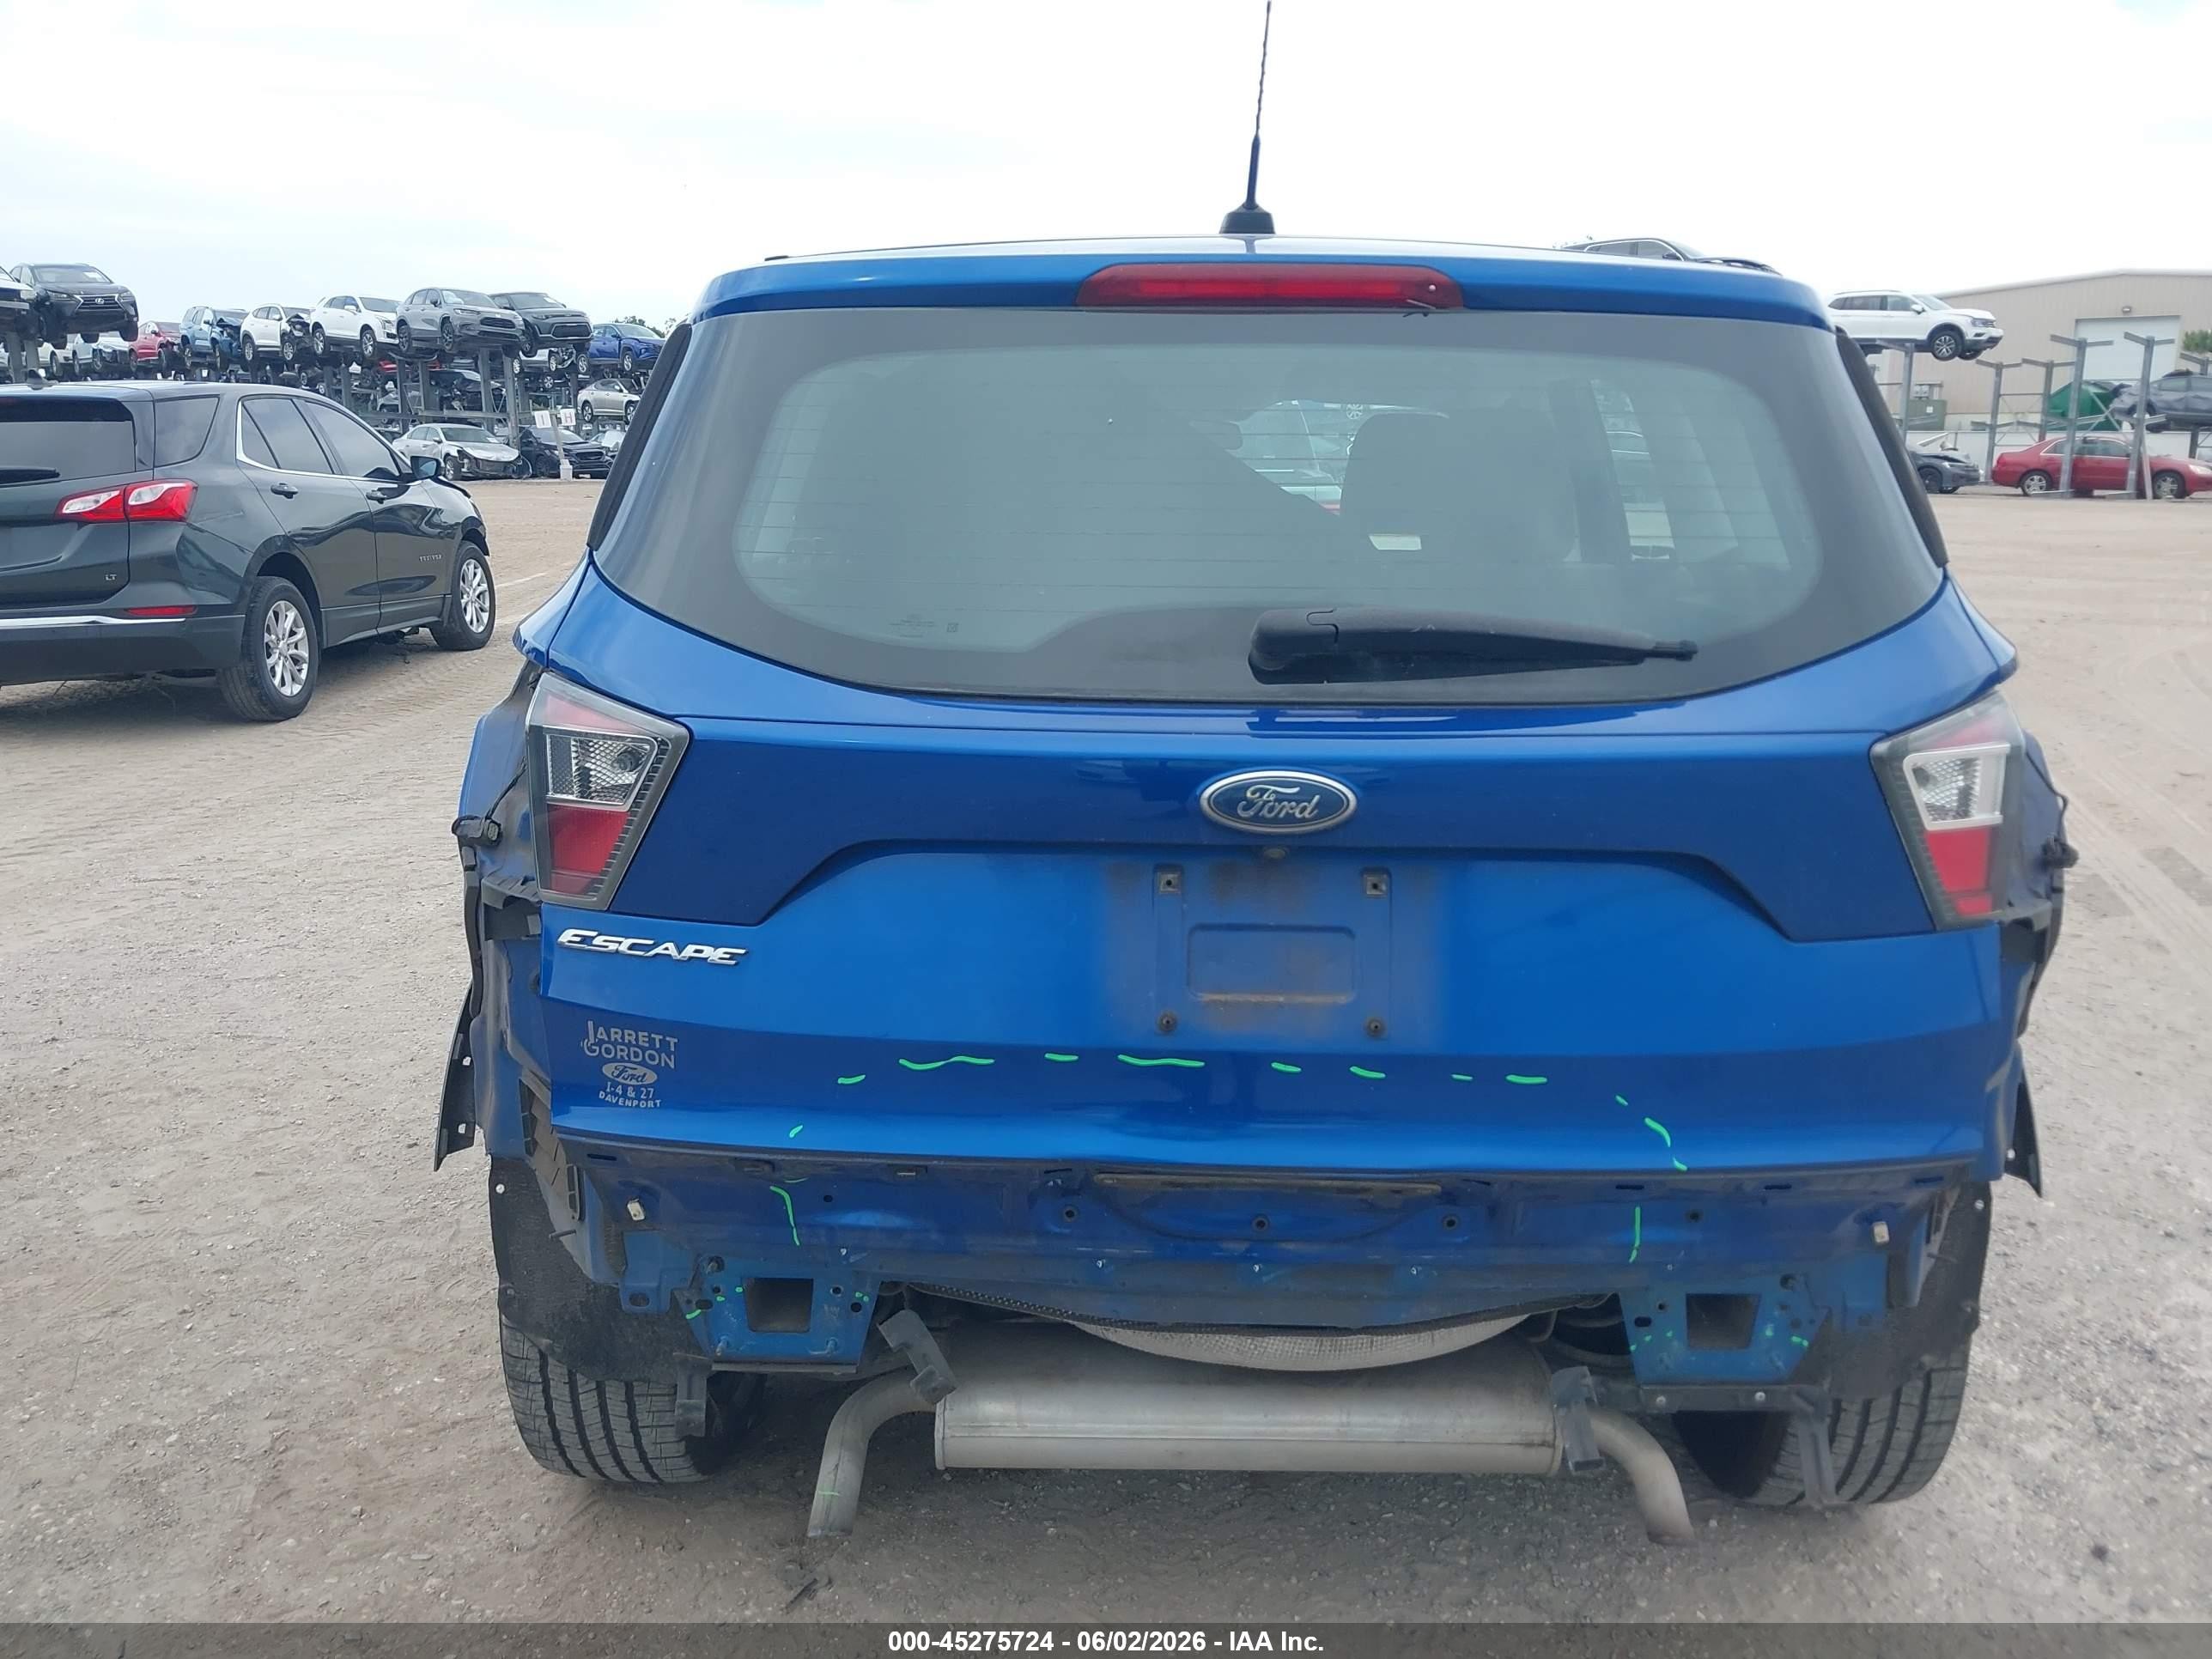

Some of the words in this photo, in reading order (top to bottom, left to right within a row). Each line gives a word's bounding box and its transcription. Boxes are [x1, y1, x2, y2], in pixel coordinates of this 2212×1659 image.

[1237, 784, 1319, 819] Ford
[556, 928, 748, 966] ESCAPE
[580, 1020, 678, 1052] JARRETT
[584, 1038, 676, 1070] GORDON
[611, 1064, 648, 1083] Ford
[599, 1091, 662, 1109] DAVENPORT
[627, 1086, 636, 1098] &
[640, 1088, 655, 1099] 27
